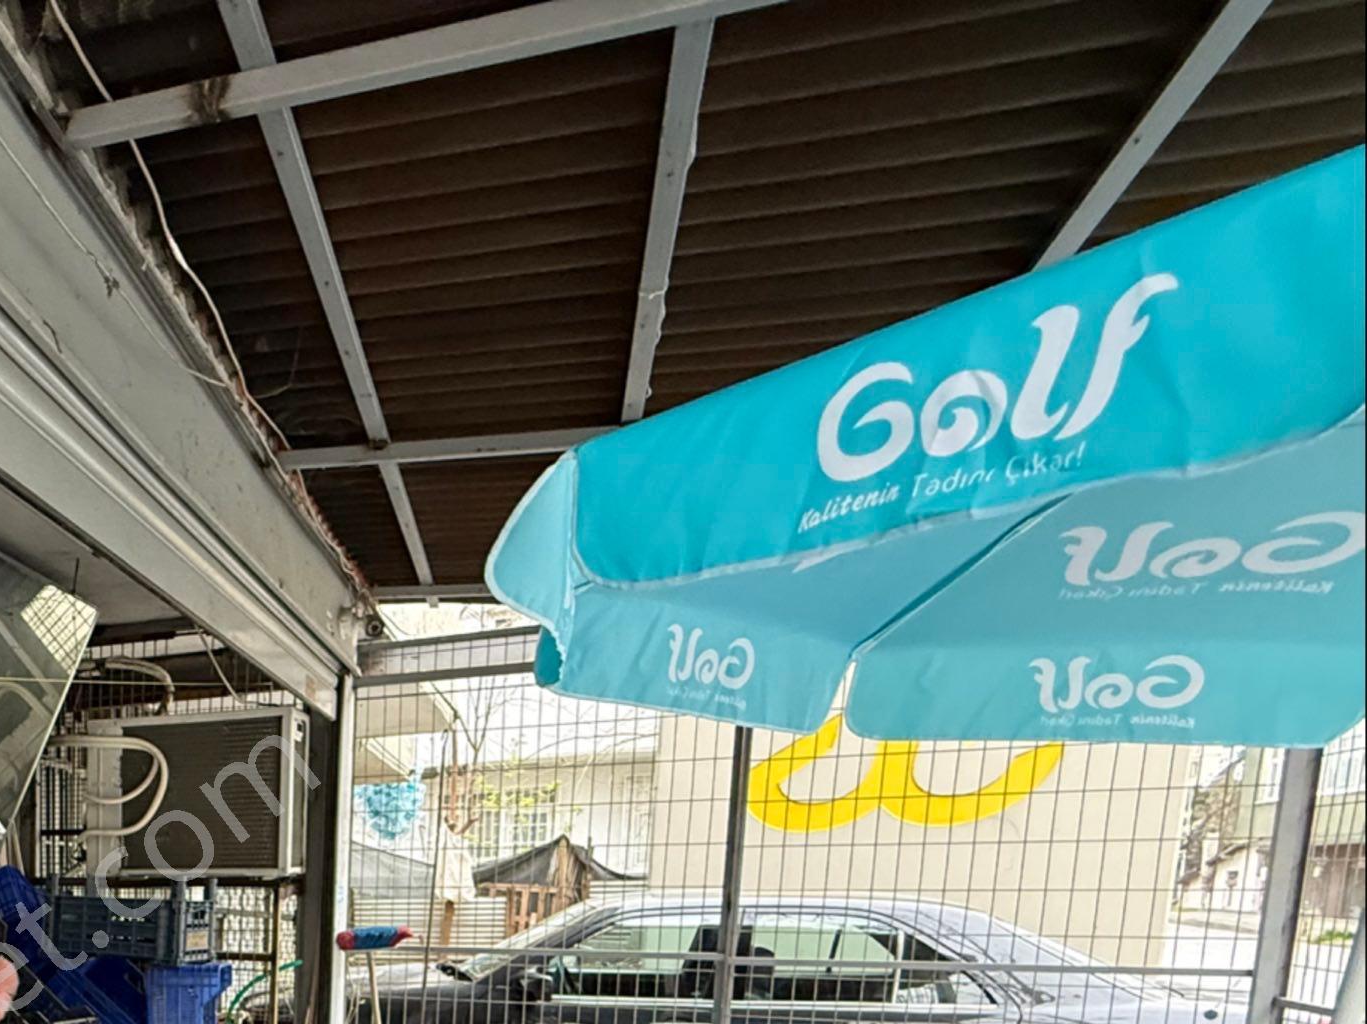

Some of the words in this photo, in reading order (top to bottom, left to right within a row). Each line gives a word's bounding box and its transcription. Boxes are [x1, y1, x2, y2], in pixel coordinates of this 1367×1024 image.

[817, 273, 1179, 481] Golf
[797, 481, 900, 534] Kalitenin
[911, 468, 995, 498] Tadını
